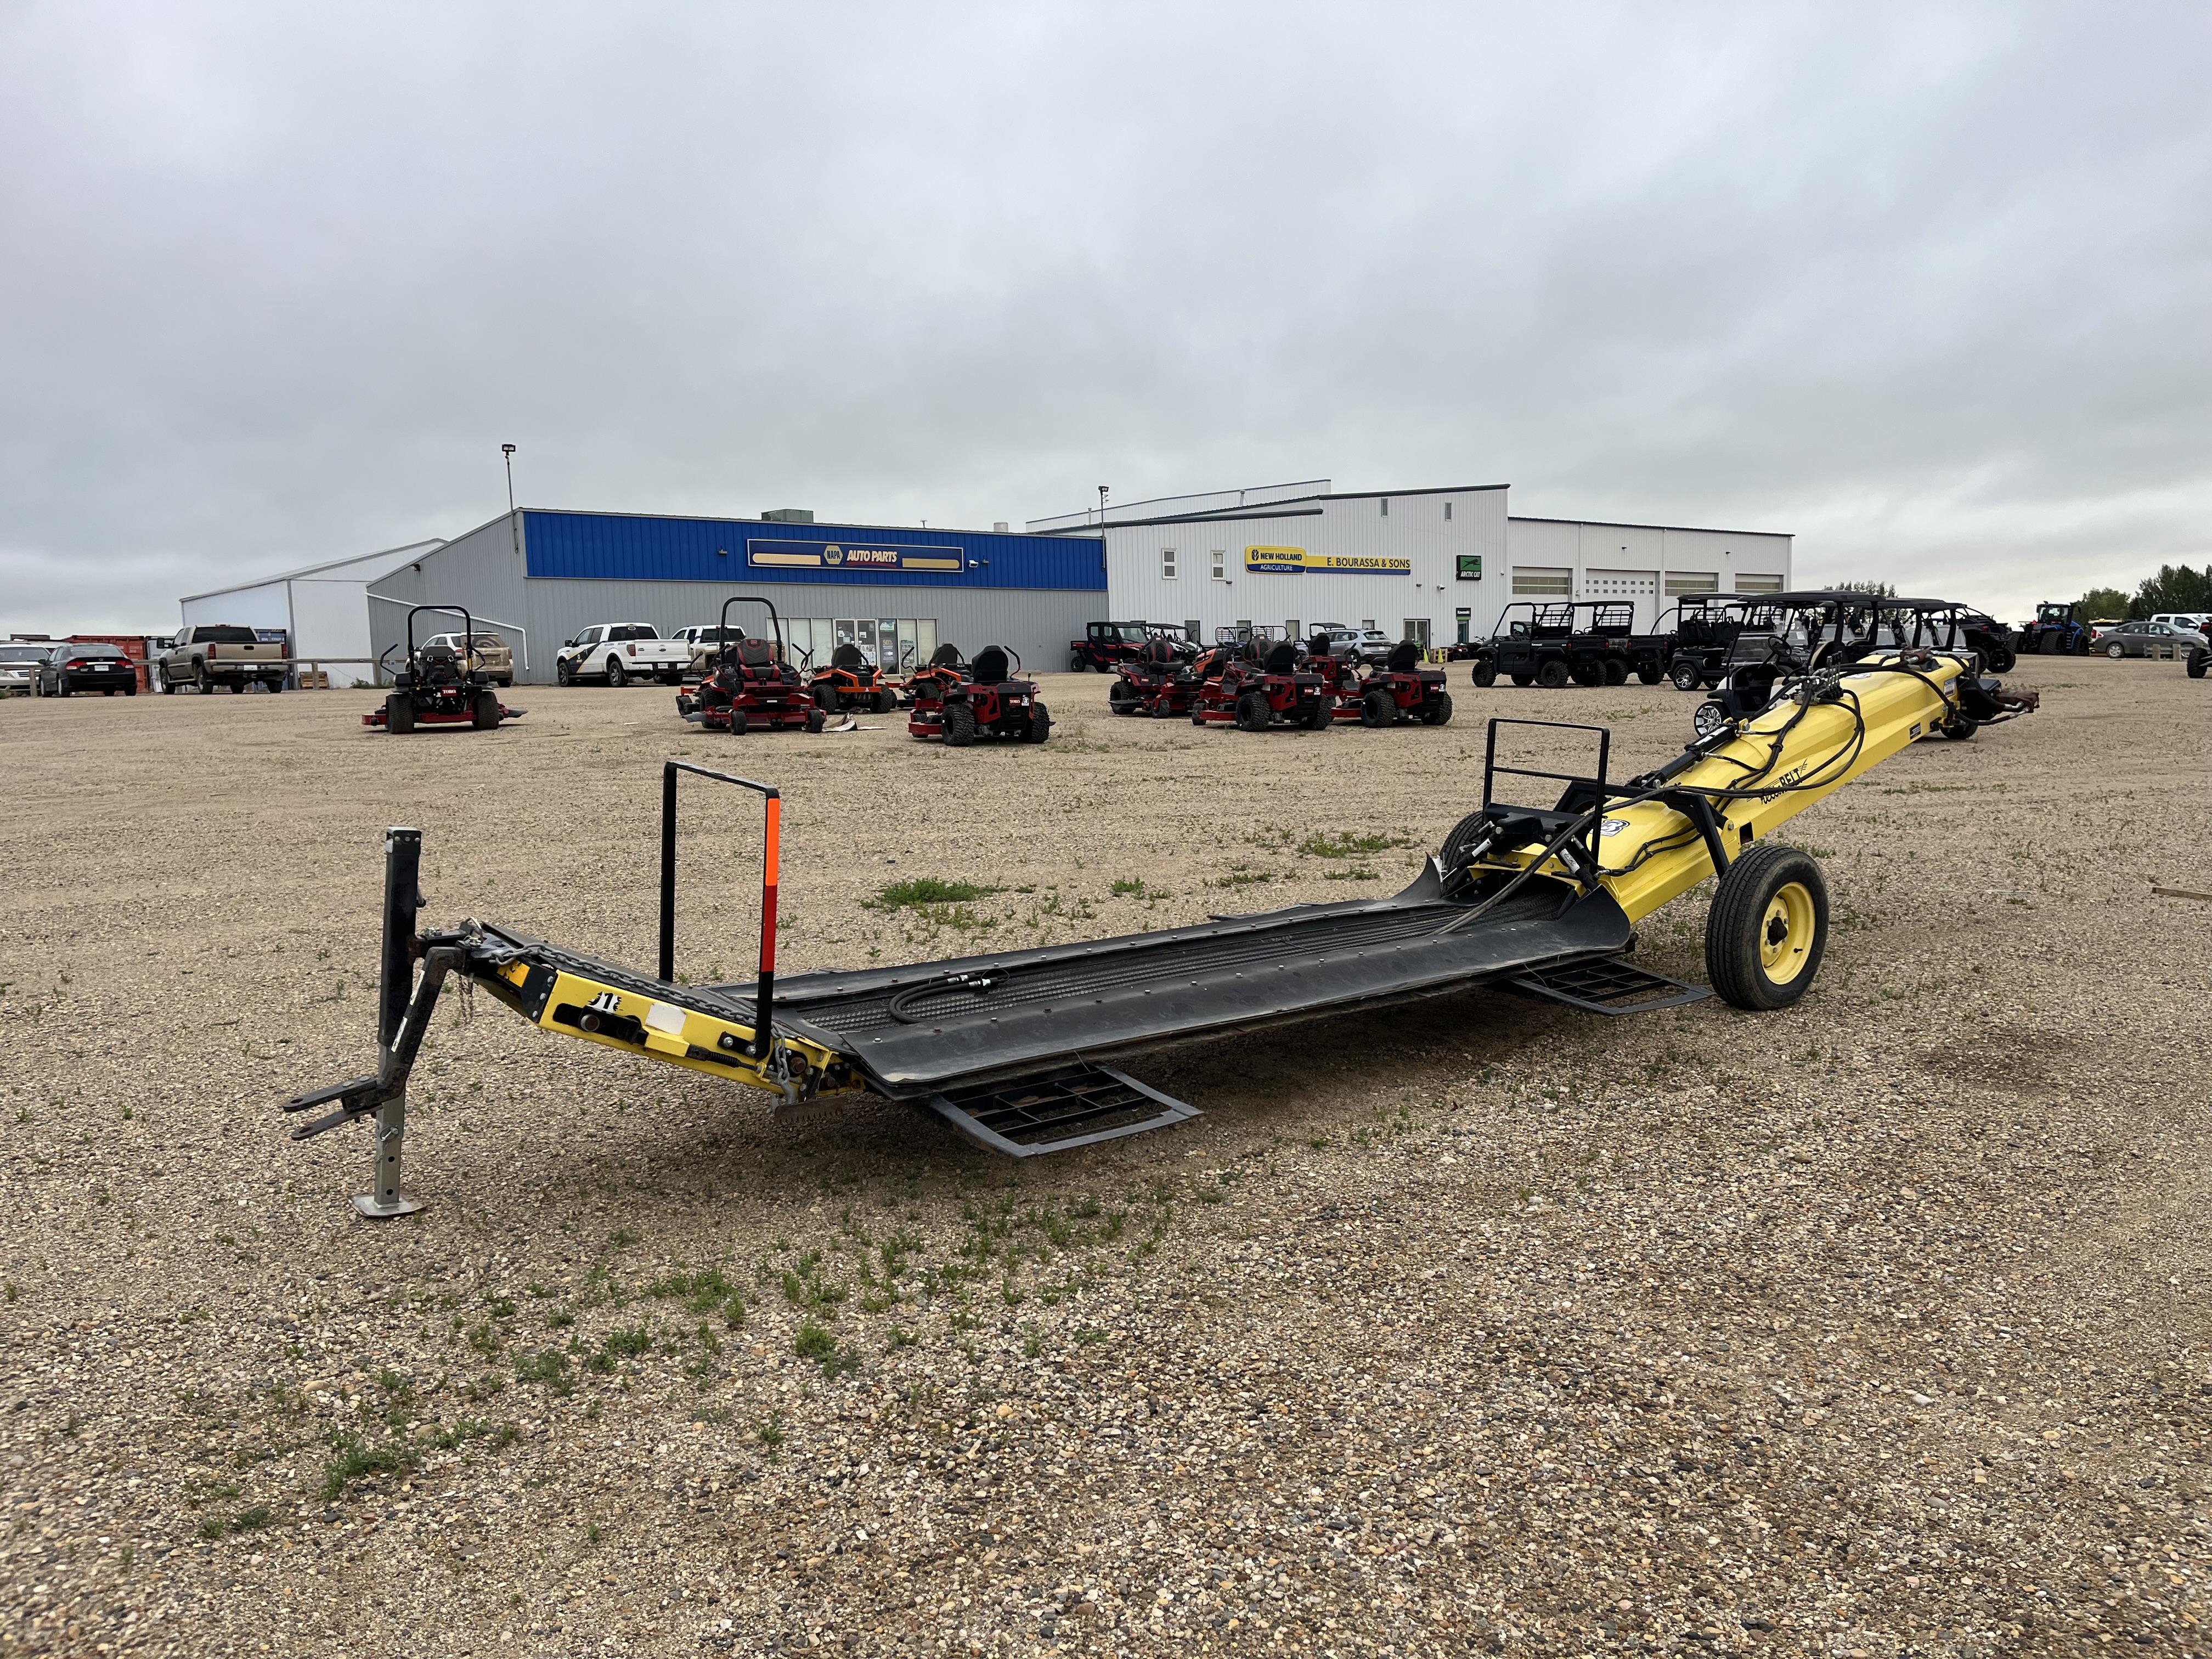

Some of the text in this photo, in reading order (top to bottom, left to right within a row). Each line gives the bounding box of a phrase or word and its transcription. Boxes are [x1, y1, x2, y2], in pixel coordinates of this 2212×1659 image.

[827, 550, 840, 559] NAPA
[847, 550, 898, 562] AUTO PARTS
[1327, 557, 1410, 568] E. BOURASSA & SONS
